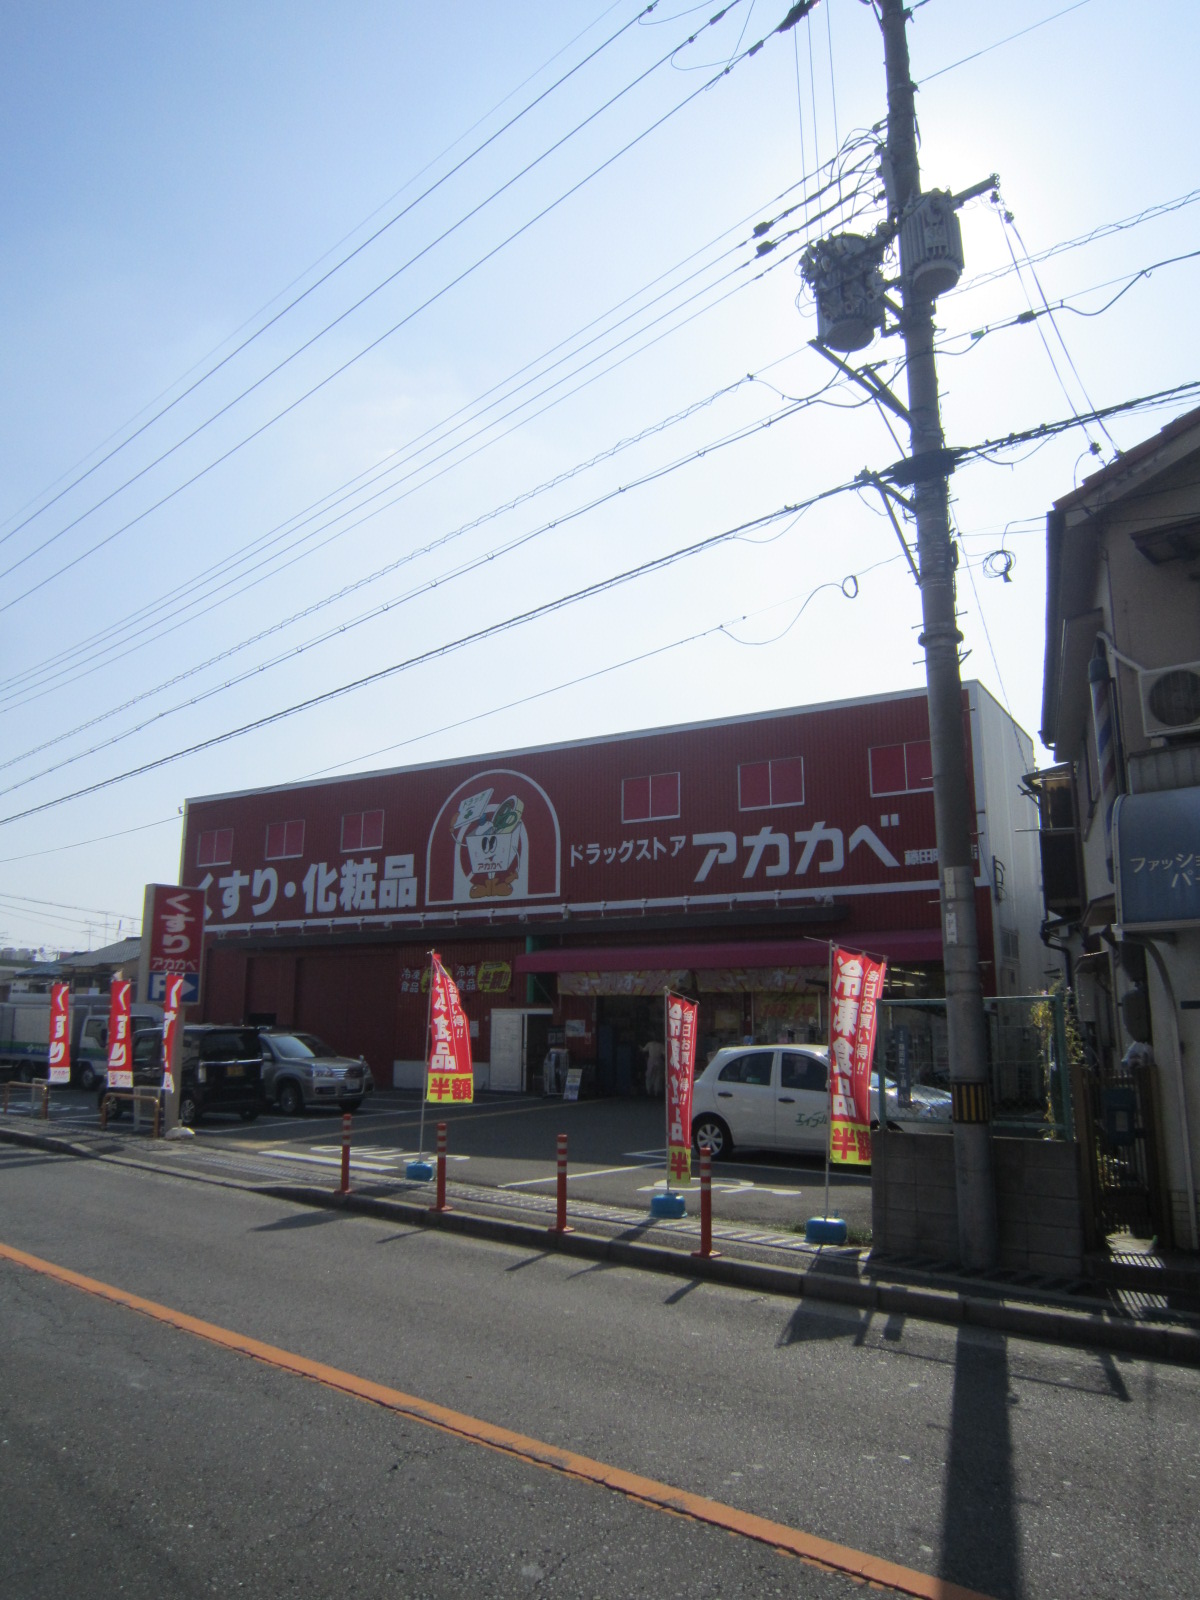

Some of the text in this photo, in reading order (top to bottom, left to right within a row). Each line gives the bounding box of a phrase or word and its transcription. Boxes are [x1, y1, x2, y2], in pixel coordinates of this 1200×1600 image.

[570, 835, 687, 868] ドラッグストア
[692, 813, 901, 882] アカカベ
[197, 853, 418, 920] くすり・化粧品
[160, 893, 195, 954] くすり
[152, 956, 199, 972] アカカベ
[50, 985, 69, 1064] くすり
[108, 983, 131, 1066] くすり
[832, 955, 863, 1119] 冷凍食品
[430, 1077, 472, 1101] 半額
